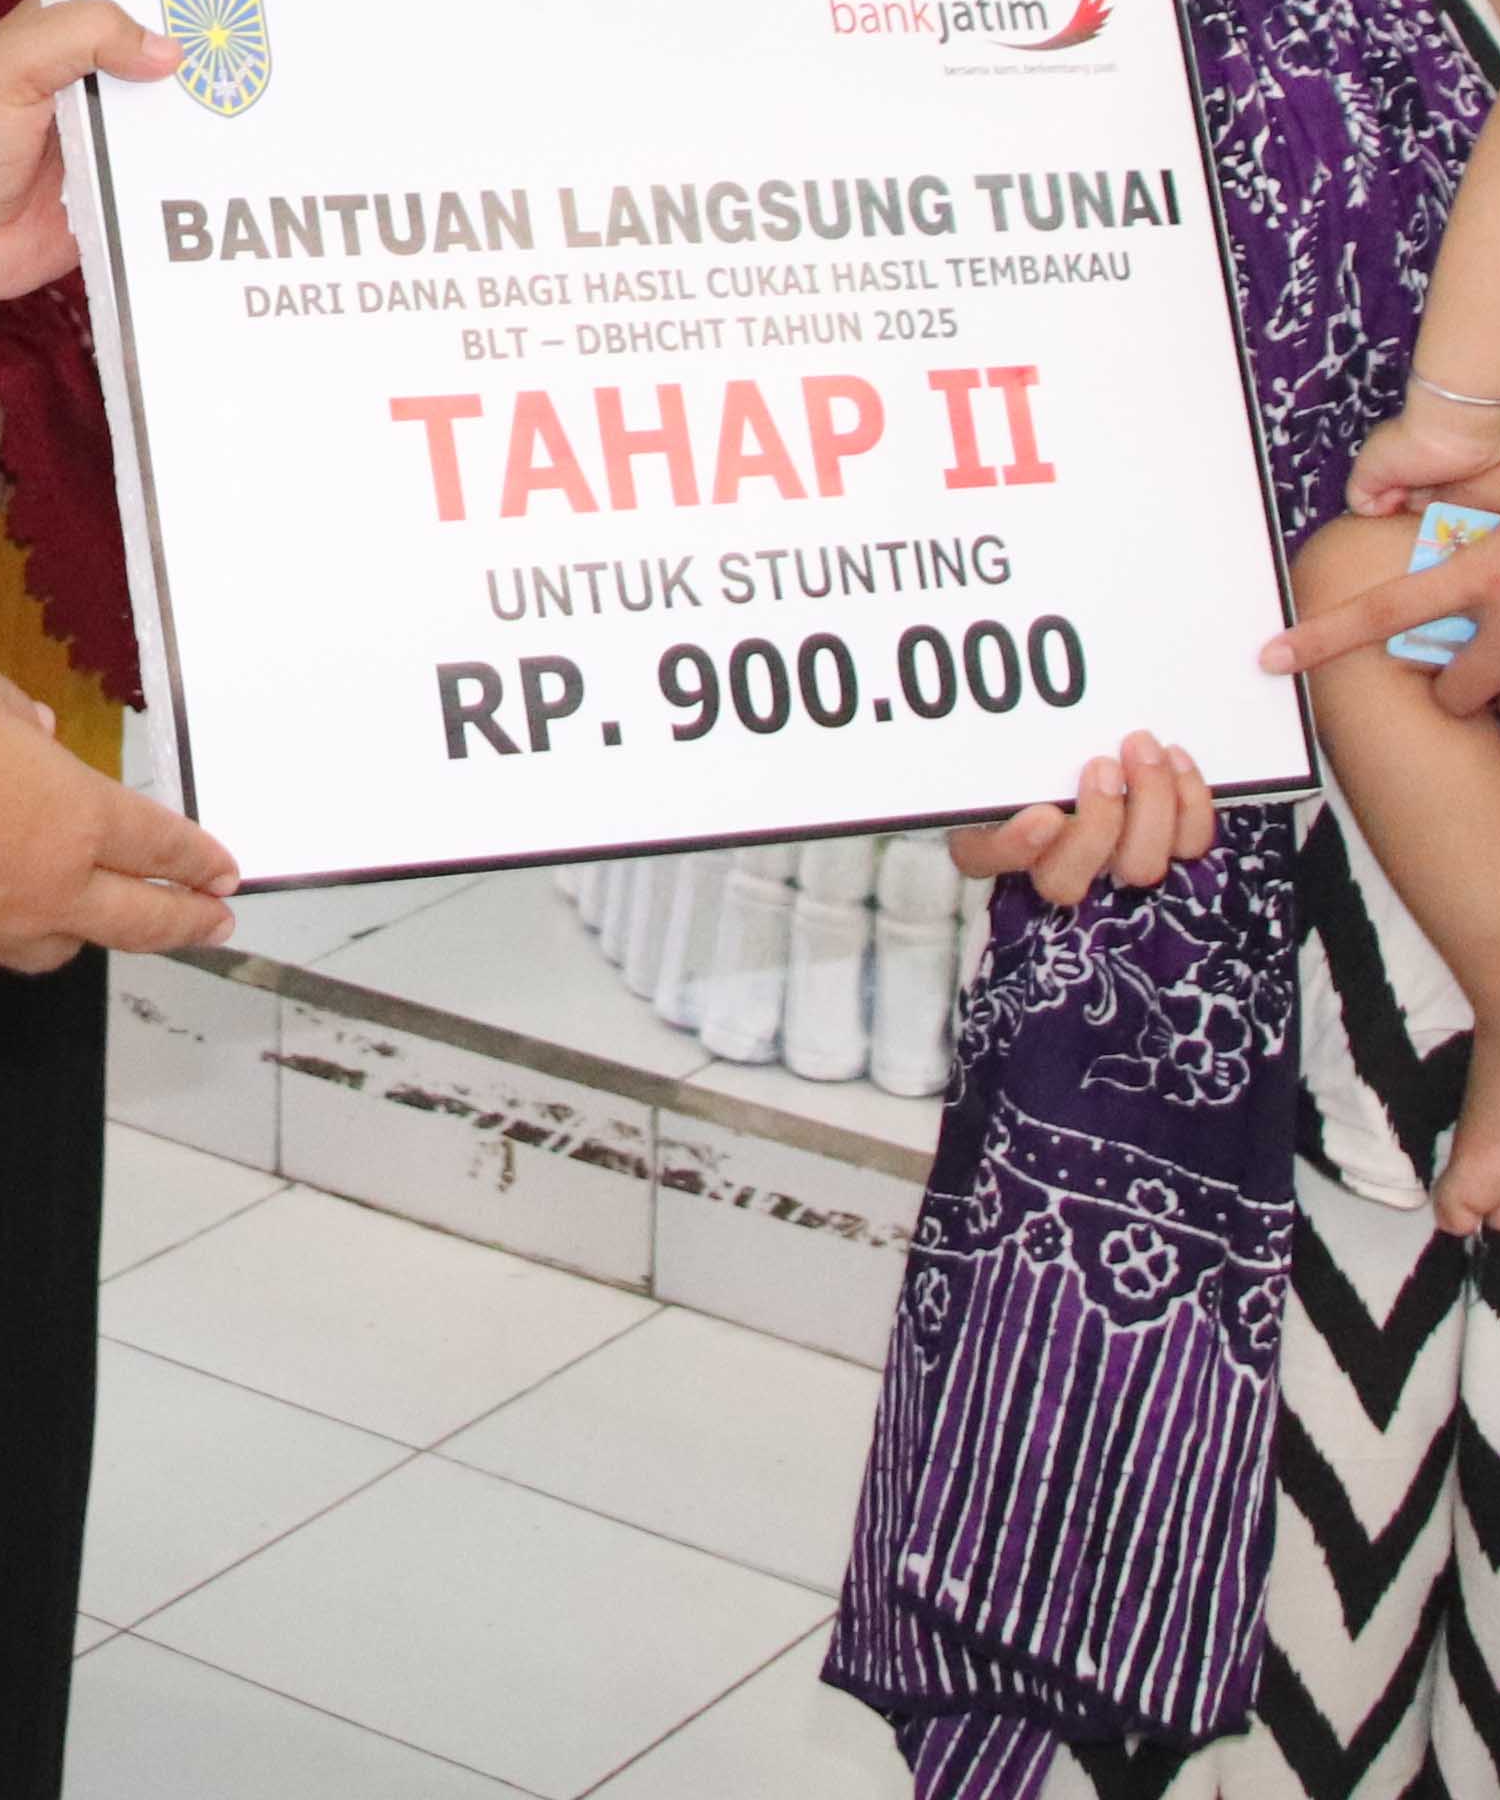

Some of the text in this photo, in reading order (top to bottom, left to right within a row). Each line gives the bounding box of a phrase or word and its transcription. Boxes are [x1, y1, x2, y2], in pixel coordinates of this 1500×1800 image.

[160, 168, 1183, 263] BANTUAN LANGSUNG TUNAI
[243, 250, 1133, 319] DARI DANA BAGI HASIL CUKAI HASIL TEMBAKAU
[461, 326, 529, 362] BLT
[575, 316, 728, 356] DBHCHT
[736, 310, 864, 349] TAHUN
[873, 307, 959, 342] 2025
[389, 363, 1057, 522] TAHAP II
[486, 533, 1012, 622] UNTUK STUNTING
[435, 612, 1086, 760] RP. 900.000
